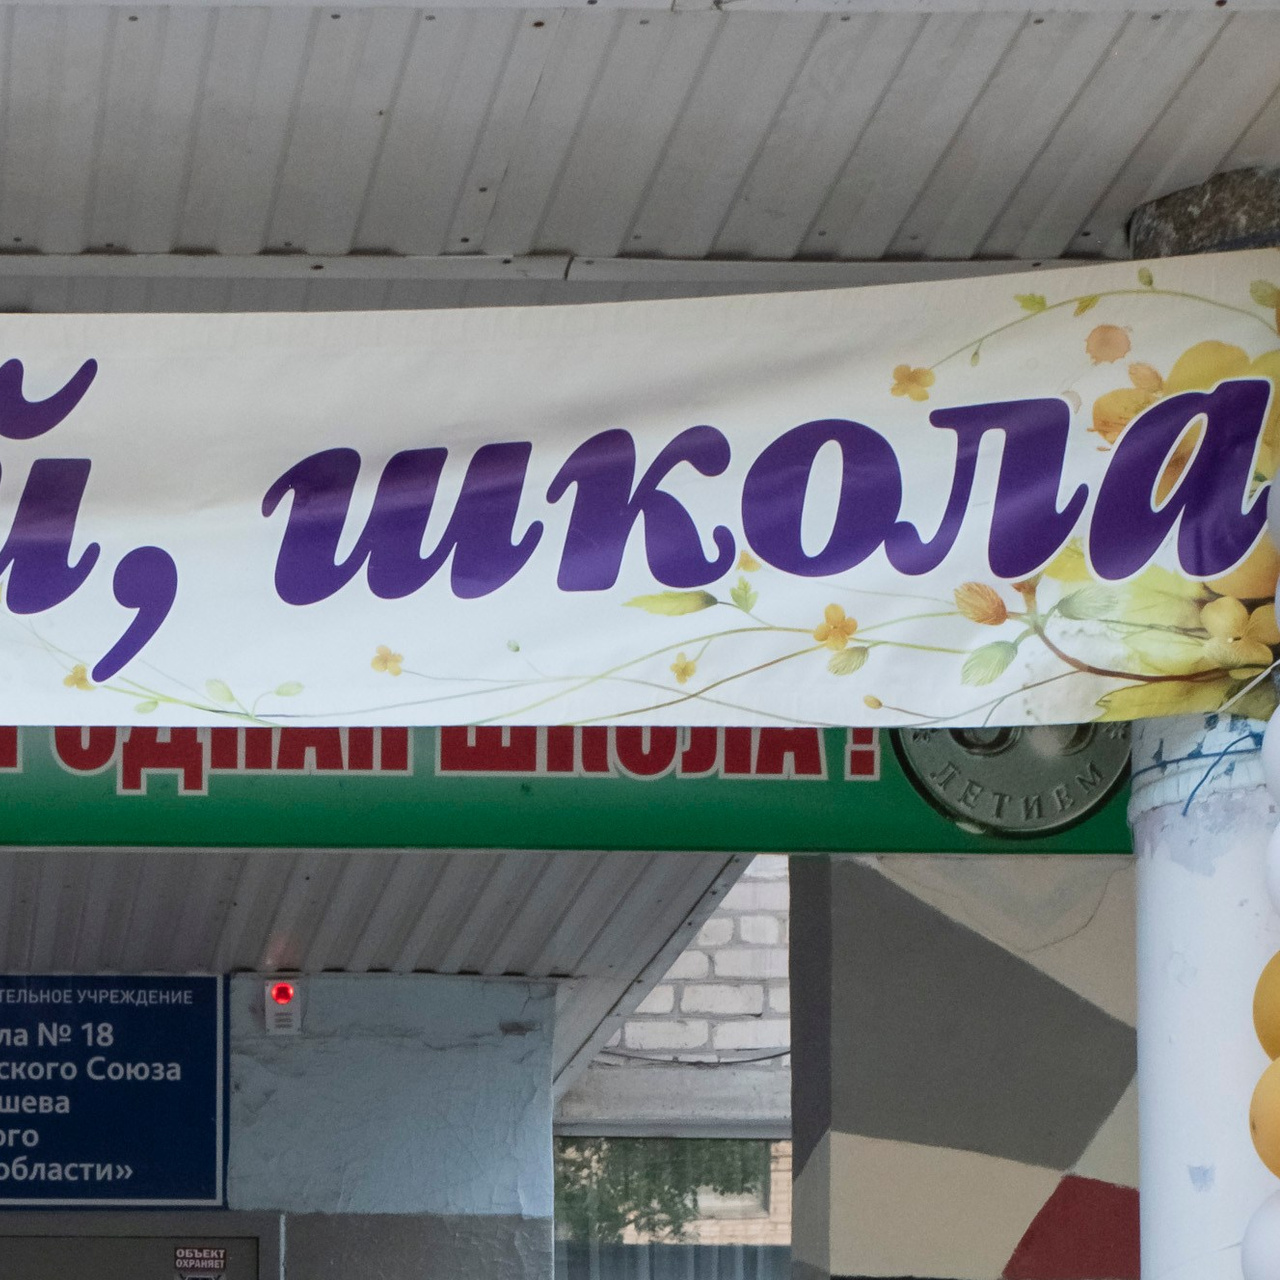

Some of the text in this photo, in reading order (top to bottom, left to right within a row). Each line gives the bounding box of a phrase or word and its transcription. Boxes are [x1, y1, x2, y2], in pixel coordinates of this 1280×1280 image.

[262, 379, 1271, 606] школа
[77, 989, 194, 1006] УЧРЕЖДЕНИЕ
[37, 1022, 72, 1047] №
[81, 1022, 114, 1047] 18
[86, 1057, 182, 1081] Союза
[175, 1248, 225, 1259] ОБЪЕКТ
[175, 1259, 225, 1269] ОХРАНЯЕТ
